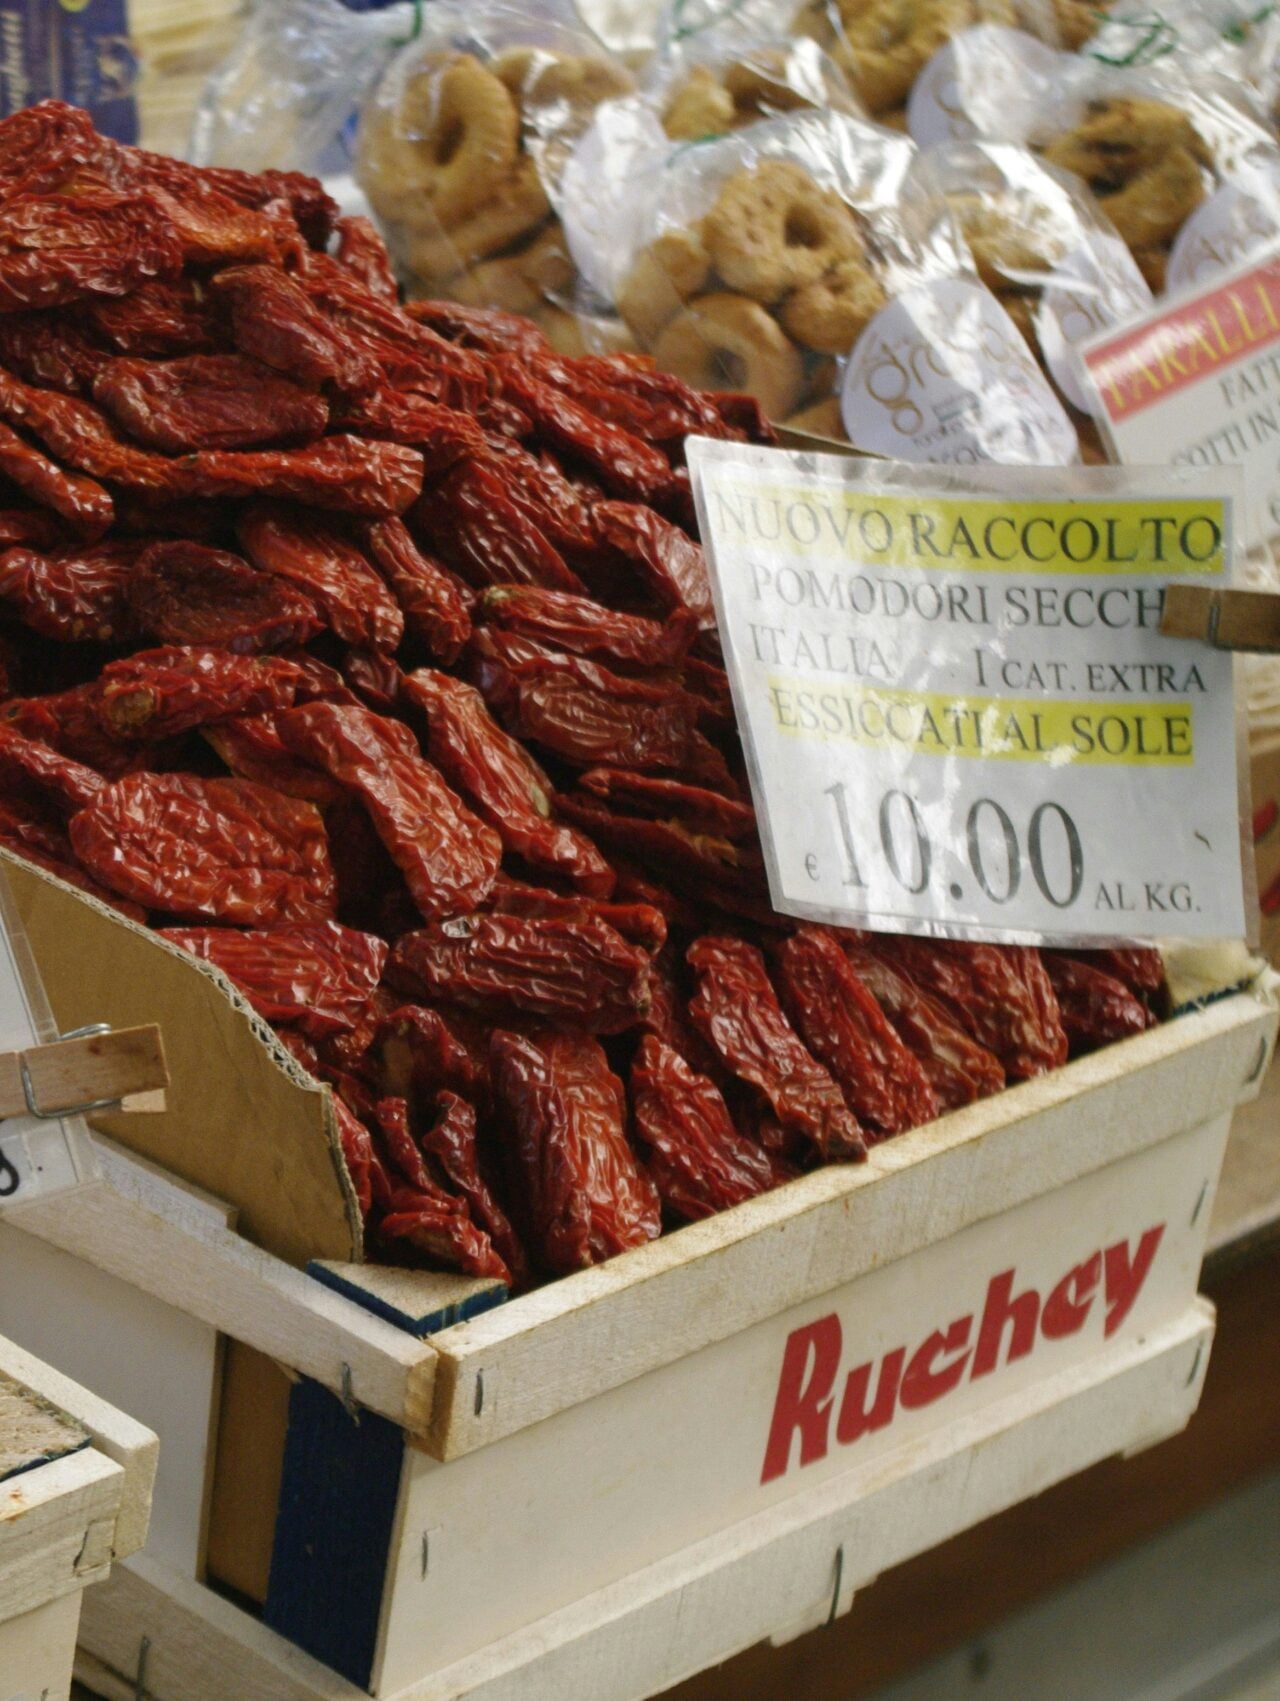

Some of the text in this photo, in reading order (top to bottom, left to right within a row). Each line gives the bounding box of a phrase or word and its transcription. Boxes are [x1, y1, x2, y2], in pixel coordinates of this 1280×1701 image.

[712, 490, 895, 554] NUOVO
[907, 511, 1222, 563] RACCOLTO
[748, 562, 1167, 629] POMODORI SECCH
[748, 622, 897, 680] ITALIA
[1000, 660, 1076, 691] CAT.
[1086, 662, 1209, 693] EXTRA
[770, 686, 1194, 757] ESSICCATI AL SOLE
[824, 782, 1085, 910] 10.00
[1094, 882, 1135, 913] AL
[1144, 884, 1202, 914] KG.
[759, 1221, 1167, 1487] Ruchey
